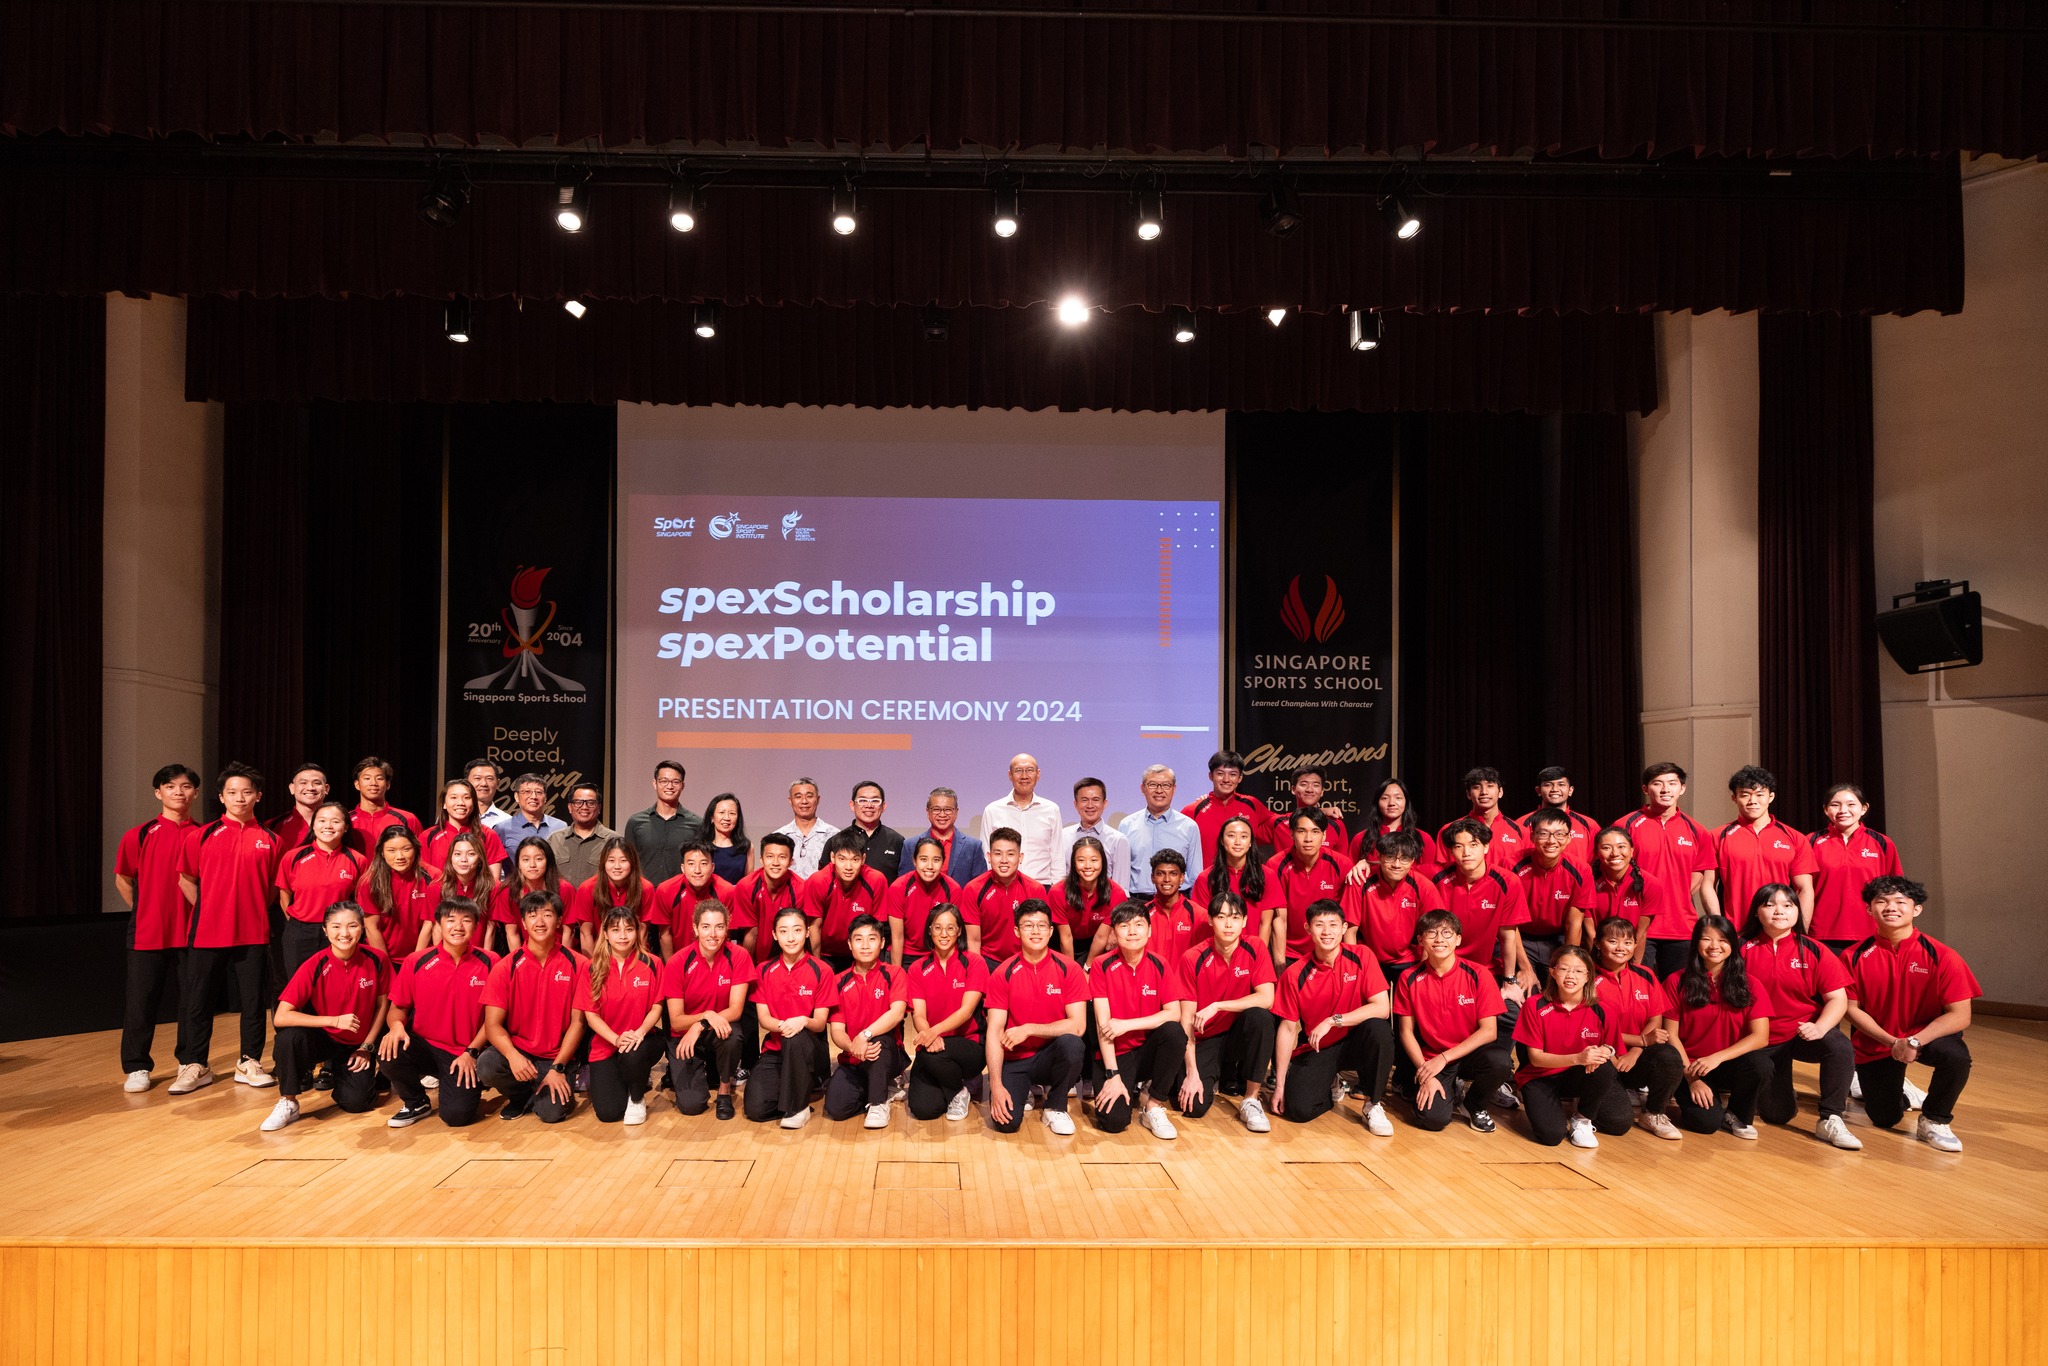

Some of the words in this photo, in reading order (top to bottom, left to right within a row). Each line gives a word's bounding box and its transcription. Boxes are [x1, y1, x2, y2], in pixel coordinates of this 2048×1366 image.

[657, 579, 1056, 626] spexScholarship
[468, 622, 501, 638] 20th
[467, 637, 502, 645] Anniversary
[546, 632, 583, 647] 2004
[656, 623, 992, 667] spexPotential
[1254, 654, 1371, 671] SINGAPORE
[1244, 676, 1307, 689] SPORTS
[1314, 677, 1383, 690] SCHOOL
[463, 692, 516, 704] Singapore
[518, 693, 551, 704] Sports
[552, 693, 587, 704] School
[1280, 700, 1319, 708] Champions
[1320, 700, 1338, 708] With
[1339, 700, 1374, 708] Character
[658, 697, 853, 720] PRESENTATION
[861, 699, 1010, 721] CEREMONY
[1016, 700, 1083, 722] 2024
[493, 726, 559, 745] Deeply
[487, 746, 565, 766] Rooted,
[1241, 742, 1389, 776] Champions
[1275, 776, 1292, 791] in
[1266, 796, 1292, 812] for
